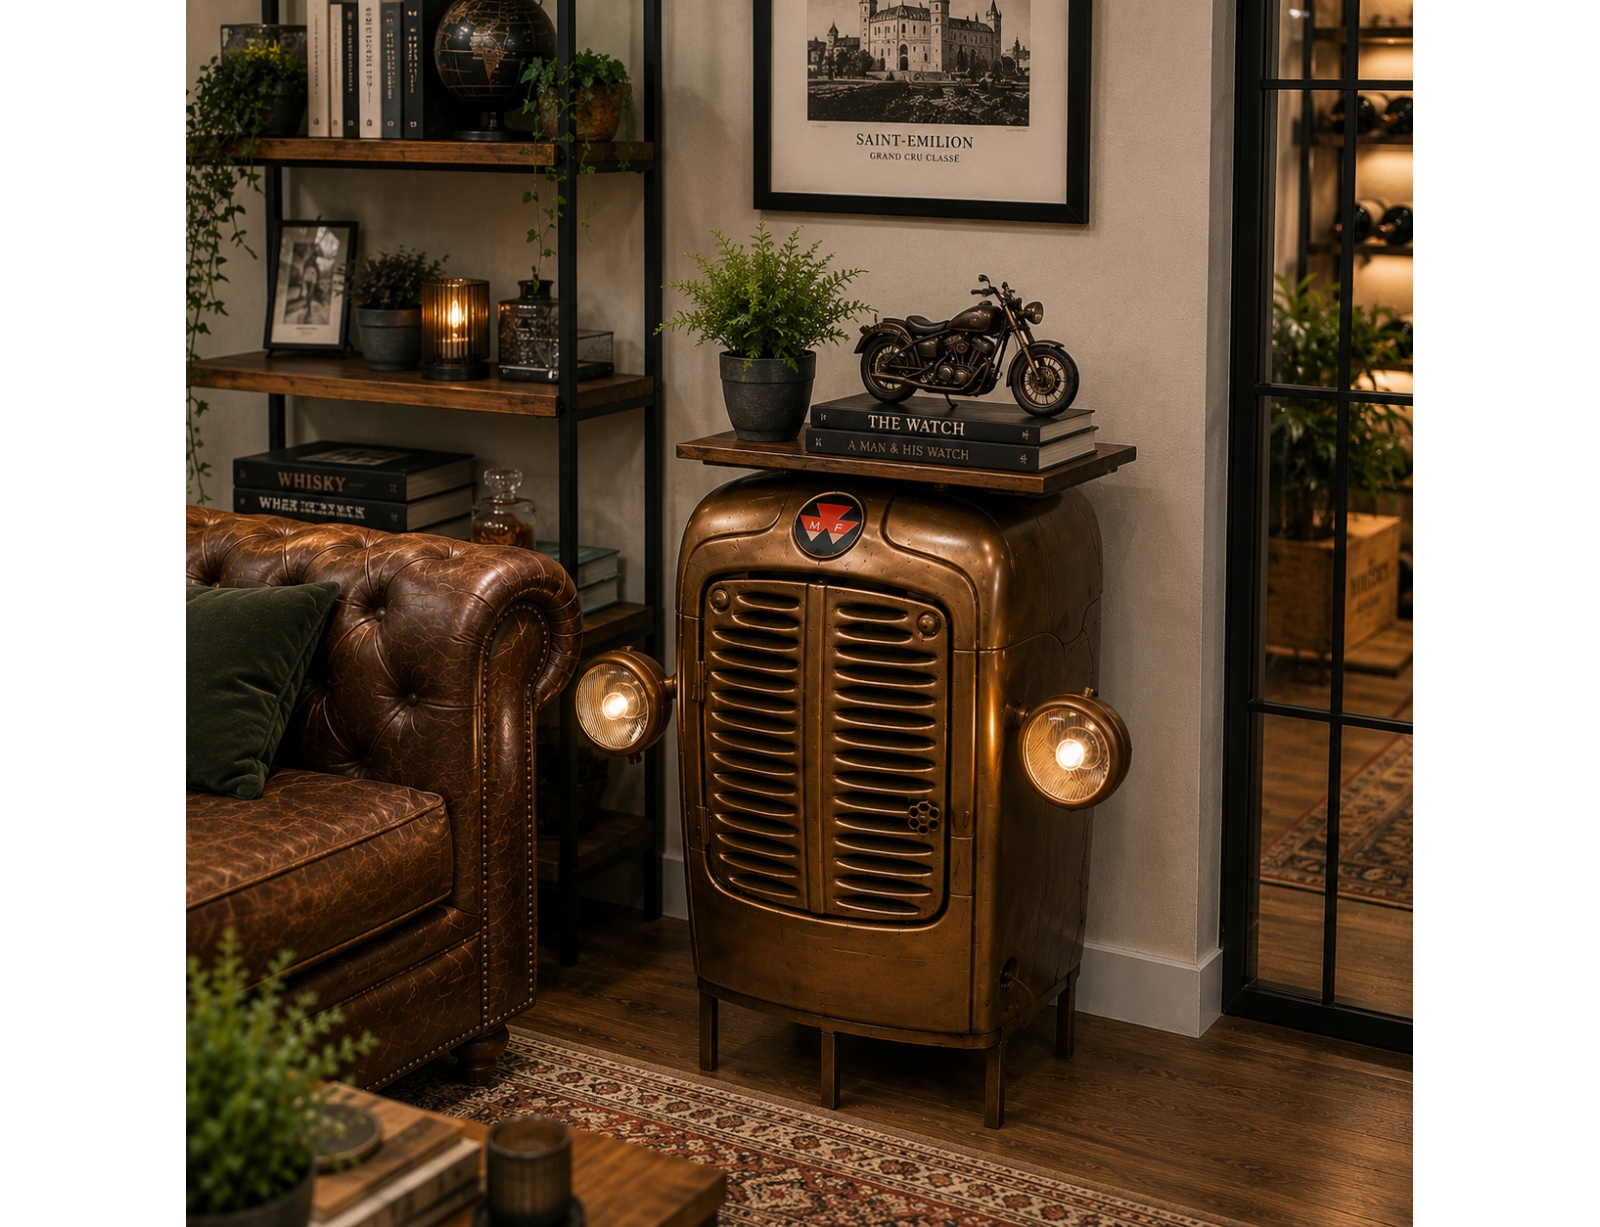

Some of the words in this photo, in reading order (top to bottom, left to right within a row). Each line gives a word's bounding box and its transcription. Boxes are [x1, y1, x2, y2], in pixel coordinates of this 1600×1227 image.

[856, 132, 974, 149] SAINT-EMILION
[869, 152, 901, 161] GRAND
[904, 153, 923, 162] CRU
[868, 414, 900, 431] THE
[906, 418, 965, 436] WATCH
[847, 440, 857, 451] A
[859, 441, 886, 454] MAN
[889, 443, 899, 455] &
[902, 444, 923, 457] HIS
[927, 446, 969, 461] WATCH
[277, 471, 346, 493] WHISKY
[809, 521, 820, 531] M
[834, 523, 844, 533] F
